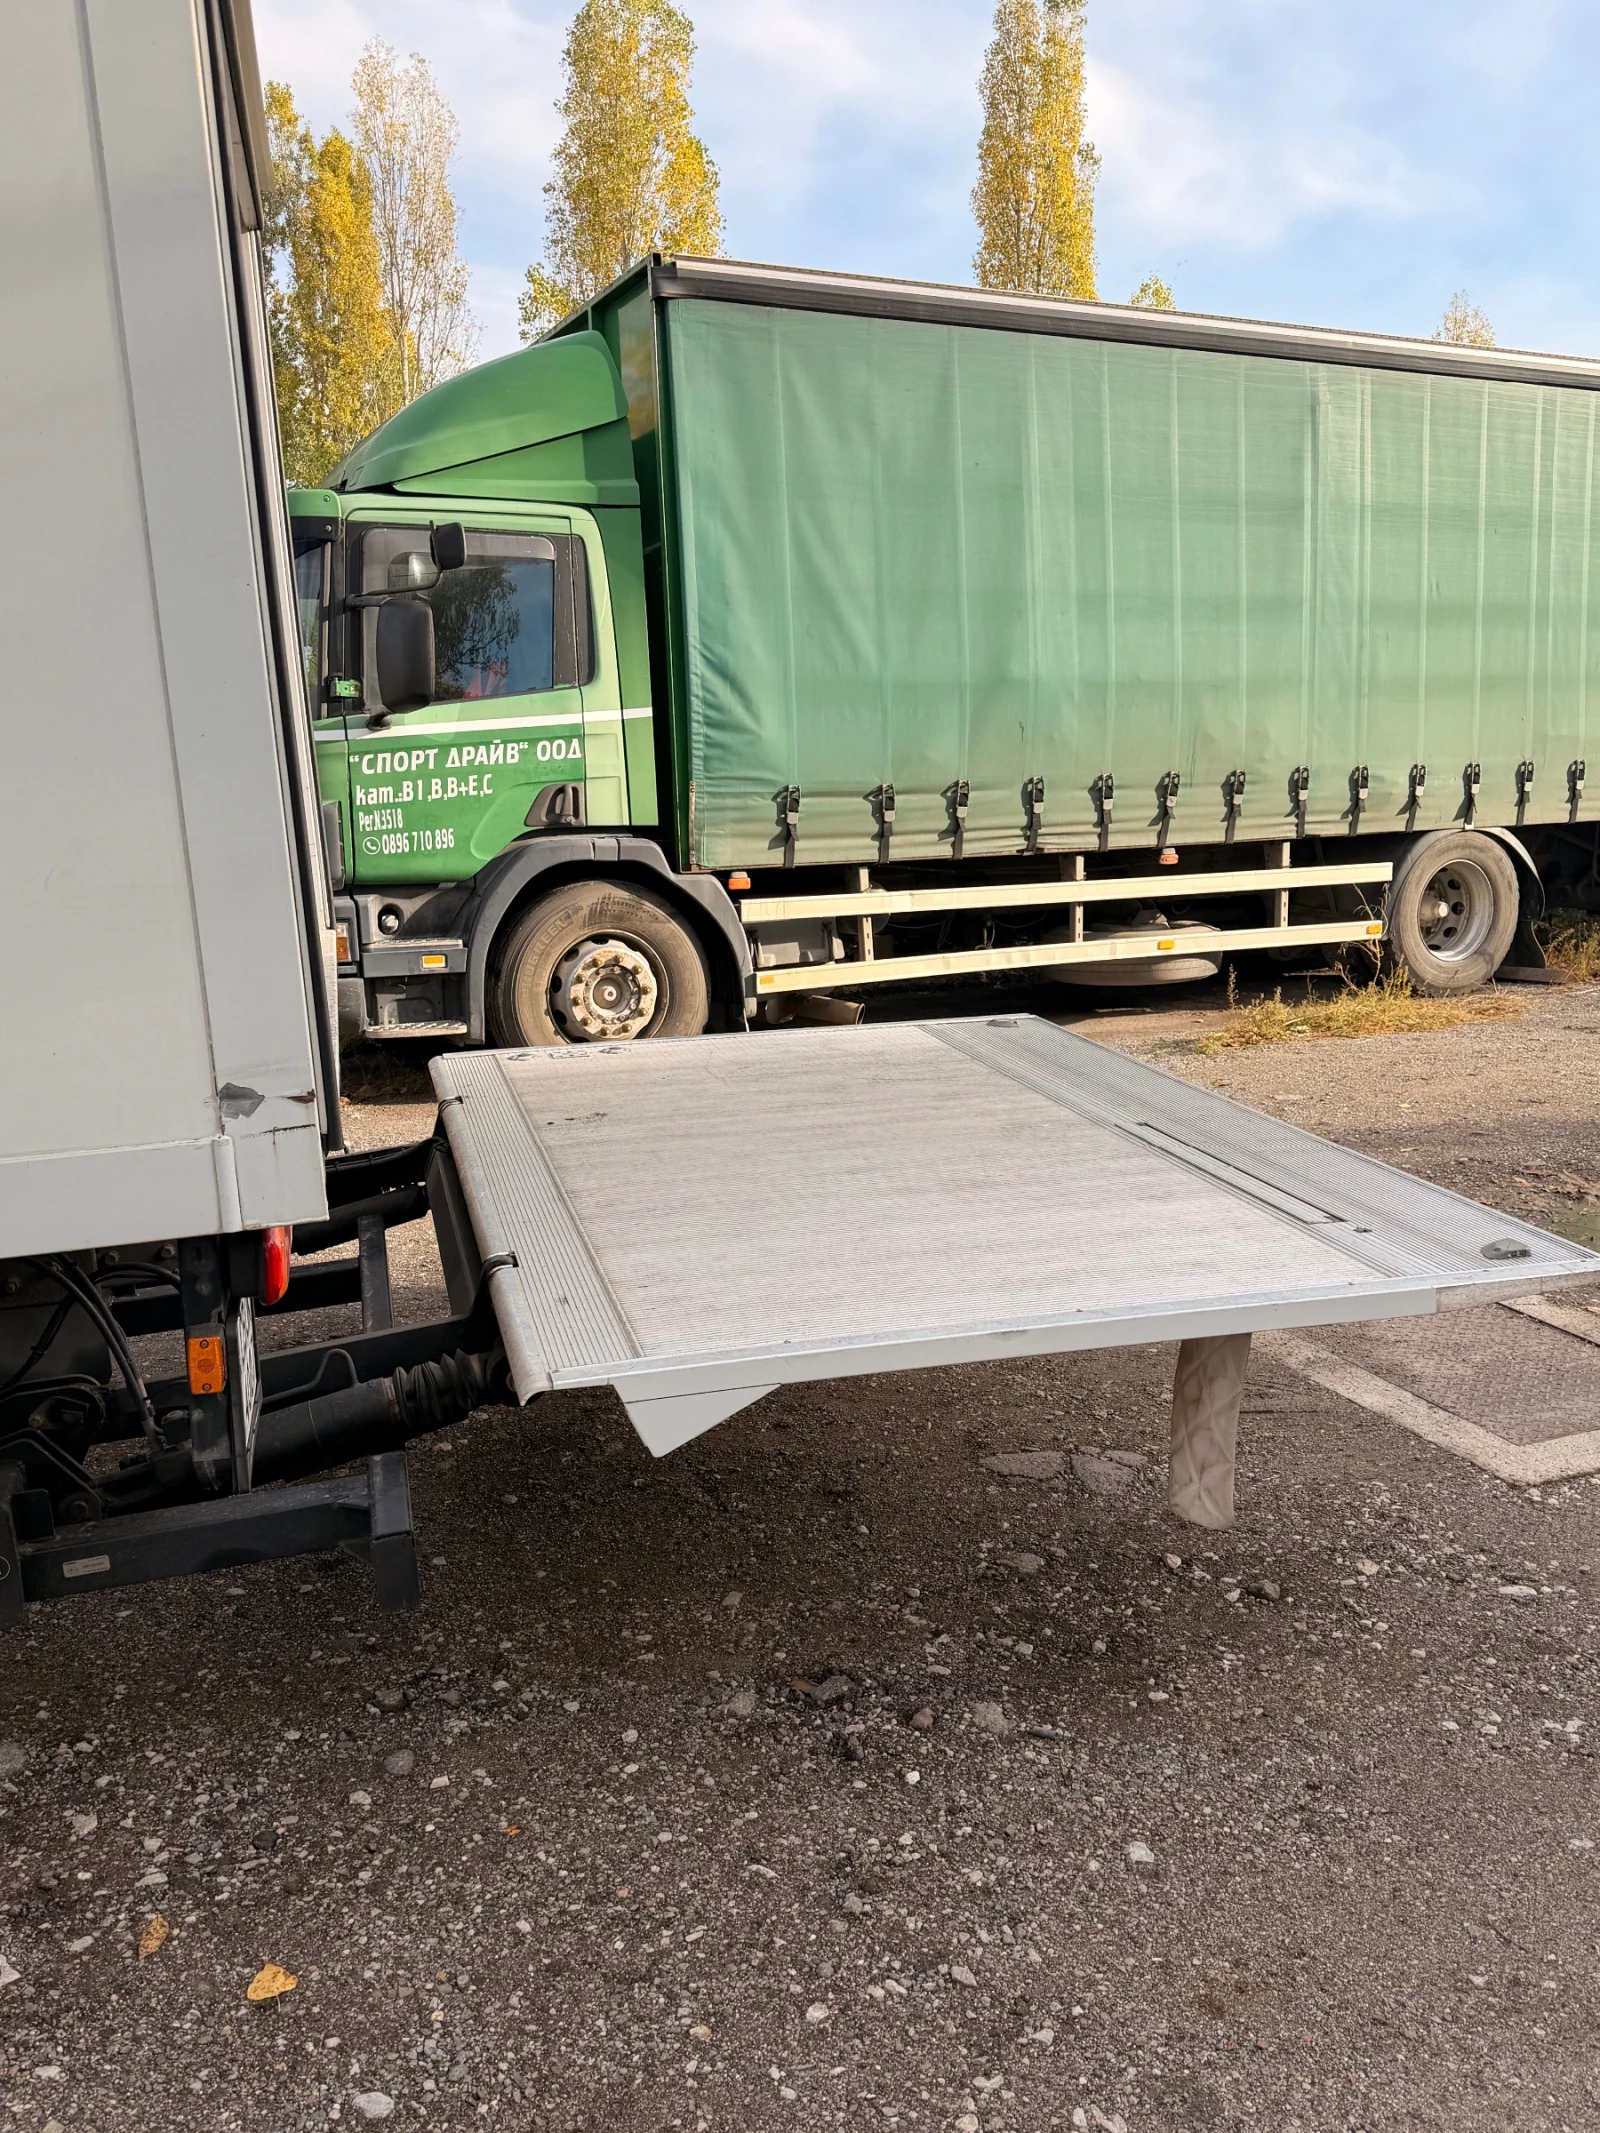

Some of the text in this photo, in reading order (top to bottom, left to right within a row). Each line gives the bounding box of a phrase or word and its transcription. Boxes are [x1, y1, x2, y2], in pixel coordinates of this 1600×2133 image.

[536, 738, 582, 762] ООД
[381, 827, 455, 855] 0896 710 896
